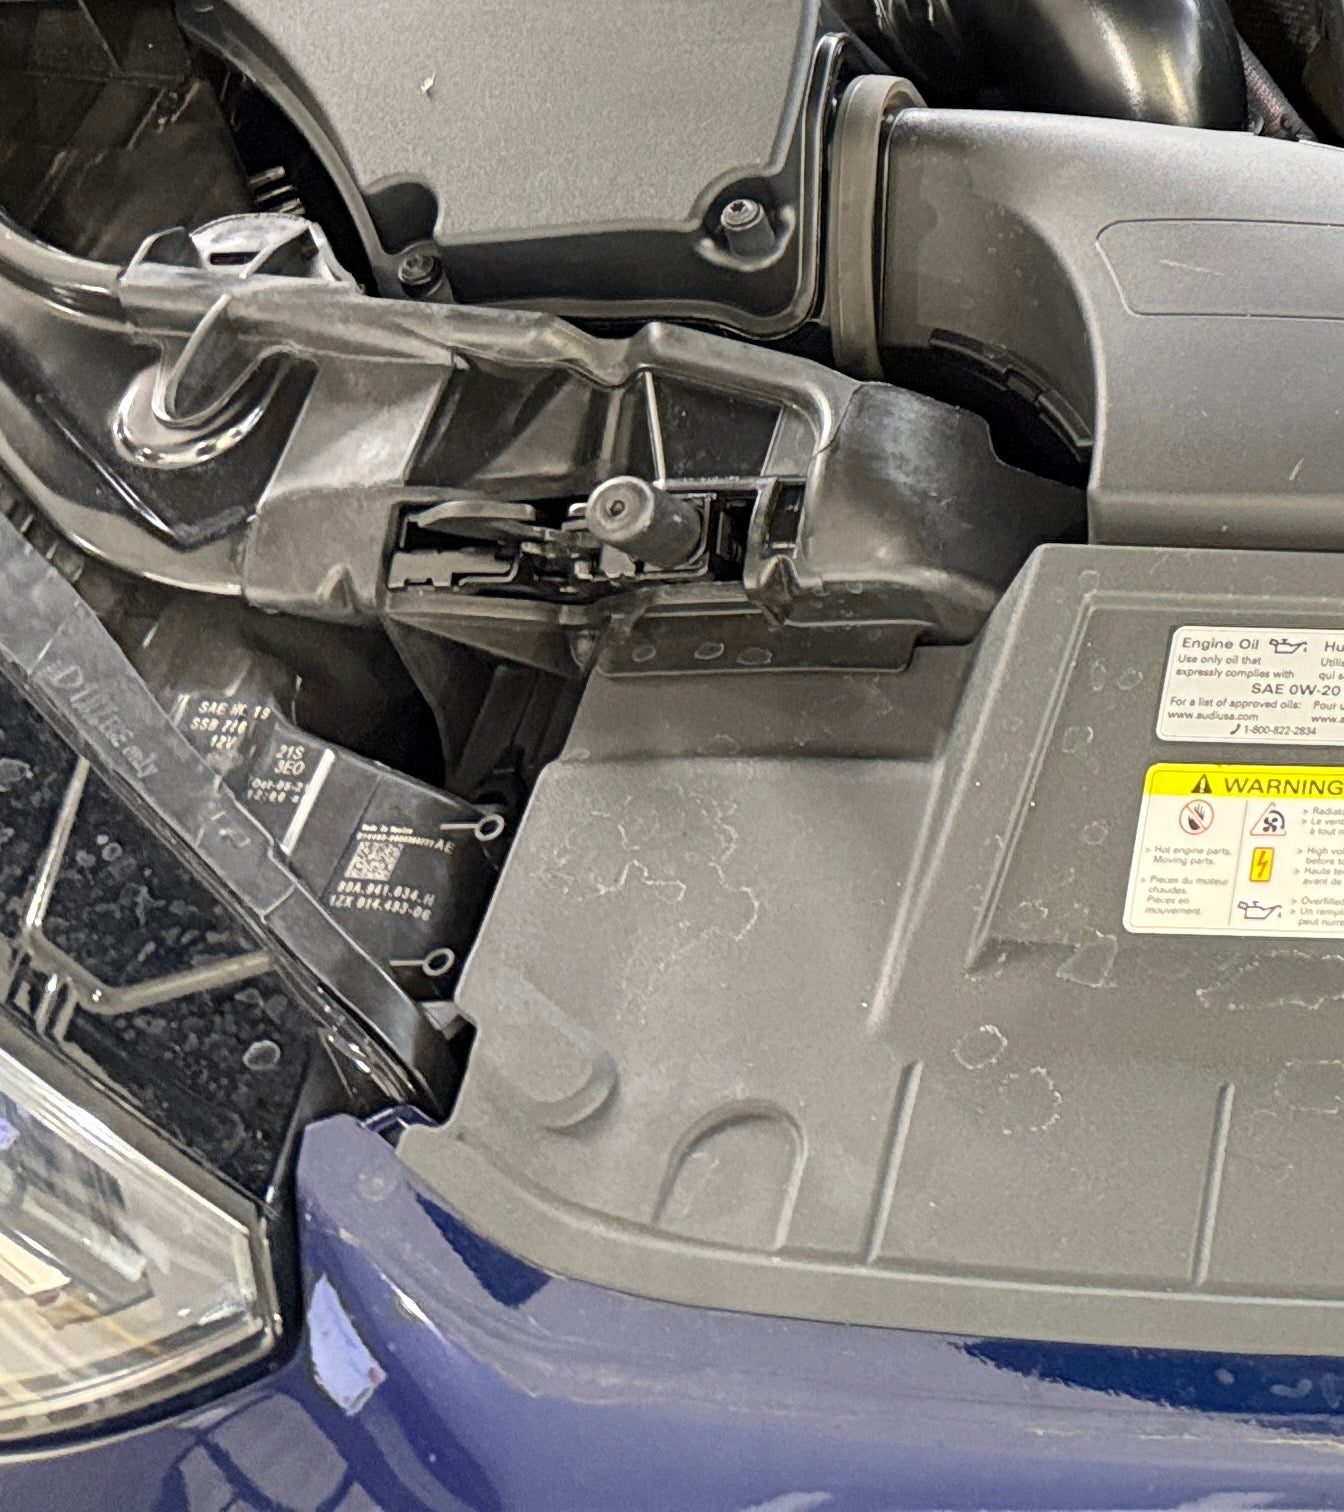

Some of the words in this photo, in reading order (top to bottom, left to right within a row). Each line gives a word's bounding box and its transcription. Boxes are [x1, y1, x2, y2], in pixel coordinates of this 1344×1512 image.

[1182, 637, 1233, 651] Engine
[1239, 638, 1259, 650] Oil
[1178, 654, 1198, 664] Use
[1200, 655, 1223, 666] only
[1225, 655, 1239, 664] oil
[1241, 656, 1262, 665] that
[1175, 668, 1223, 679] expressly
[1225, 669, 1270, 679] complies
[1273, 669, 1295, 679] with
[1318, 671, 1336, 682] qui
[1251, 682, 1285, 695] SAE
[1288, 683, 1341, 697] 0W-20
[198, 701, 228, 715] SAE
[1170, 696, 1187, 706] For
[1189, 698, 1196, 706] a
[1198, 697, 1214, 707] list
[1216, 698, 1228, 707] of
[1229, 699, 1277, 710] approved
[1313, 700, 1337, 711] Pour
[1167, 710, 1259, 722] www.audiusa.com
[1244, 724, 1317, 736] 1-800-822-2834
[210, 734, 238, 749] 12V
[1225, 778, 1344, 795] WARNING
[434, 839, 456, 854] AE
[1173, 847, 1204, 856] engine
[1307, 847, 1329, 857] High
[1153, 856, 1188, 866] Moving
[1306, 857, 1335, 865] before
[1304, 867, 1331, 875] Haute
[1182, 876, 1194, 885] du
[1196, 877, 1229, 885] moteur
[1302, 878, 1327, 886] avant
[1330, 878, 1342, 886] de
[1300, 907, 1314, 915] Un
